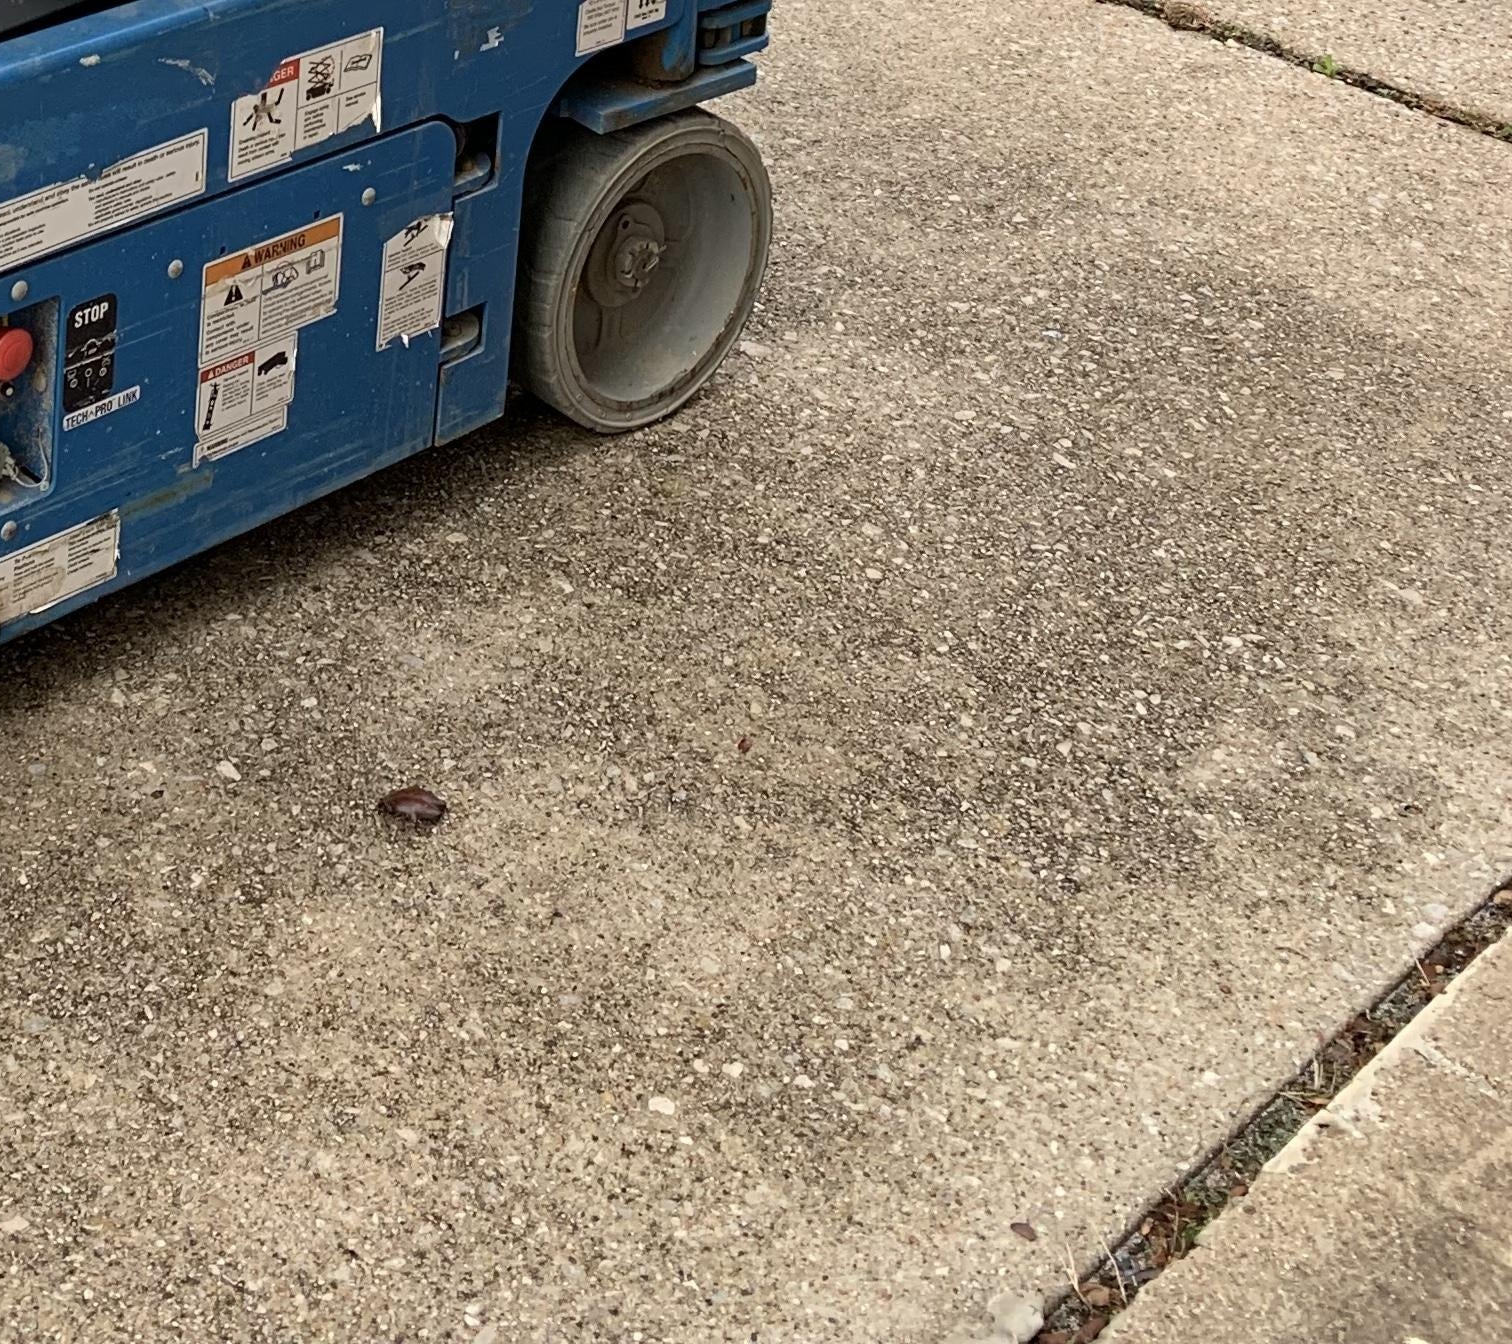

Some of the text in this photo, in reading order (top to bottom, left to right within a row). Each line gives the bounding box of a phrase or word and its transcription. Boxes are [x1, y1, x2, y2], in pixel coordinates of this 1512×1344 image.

[254, 233, 307, 264] WARNING
[74, 302, 109, 328] STOP
[215, 355, 249, 374] DANGER
[118, 389, 139, 407] LINK
